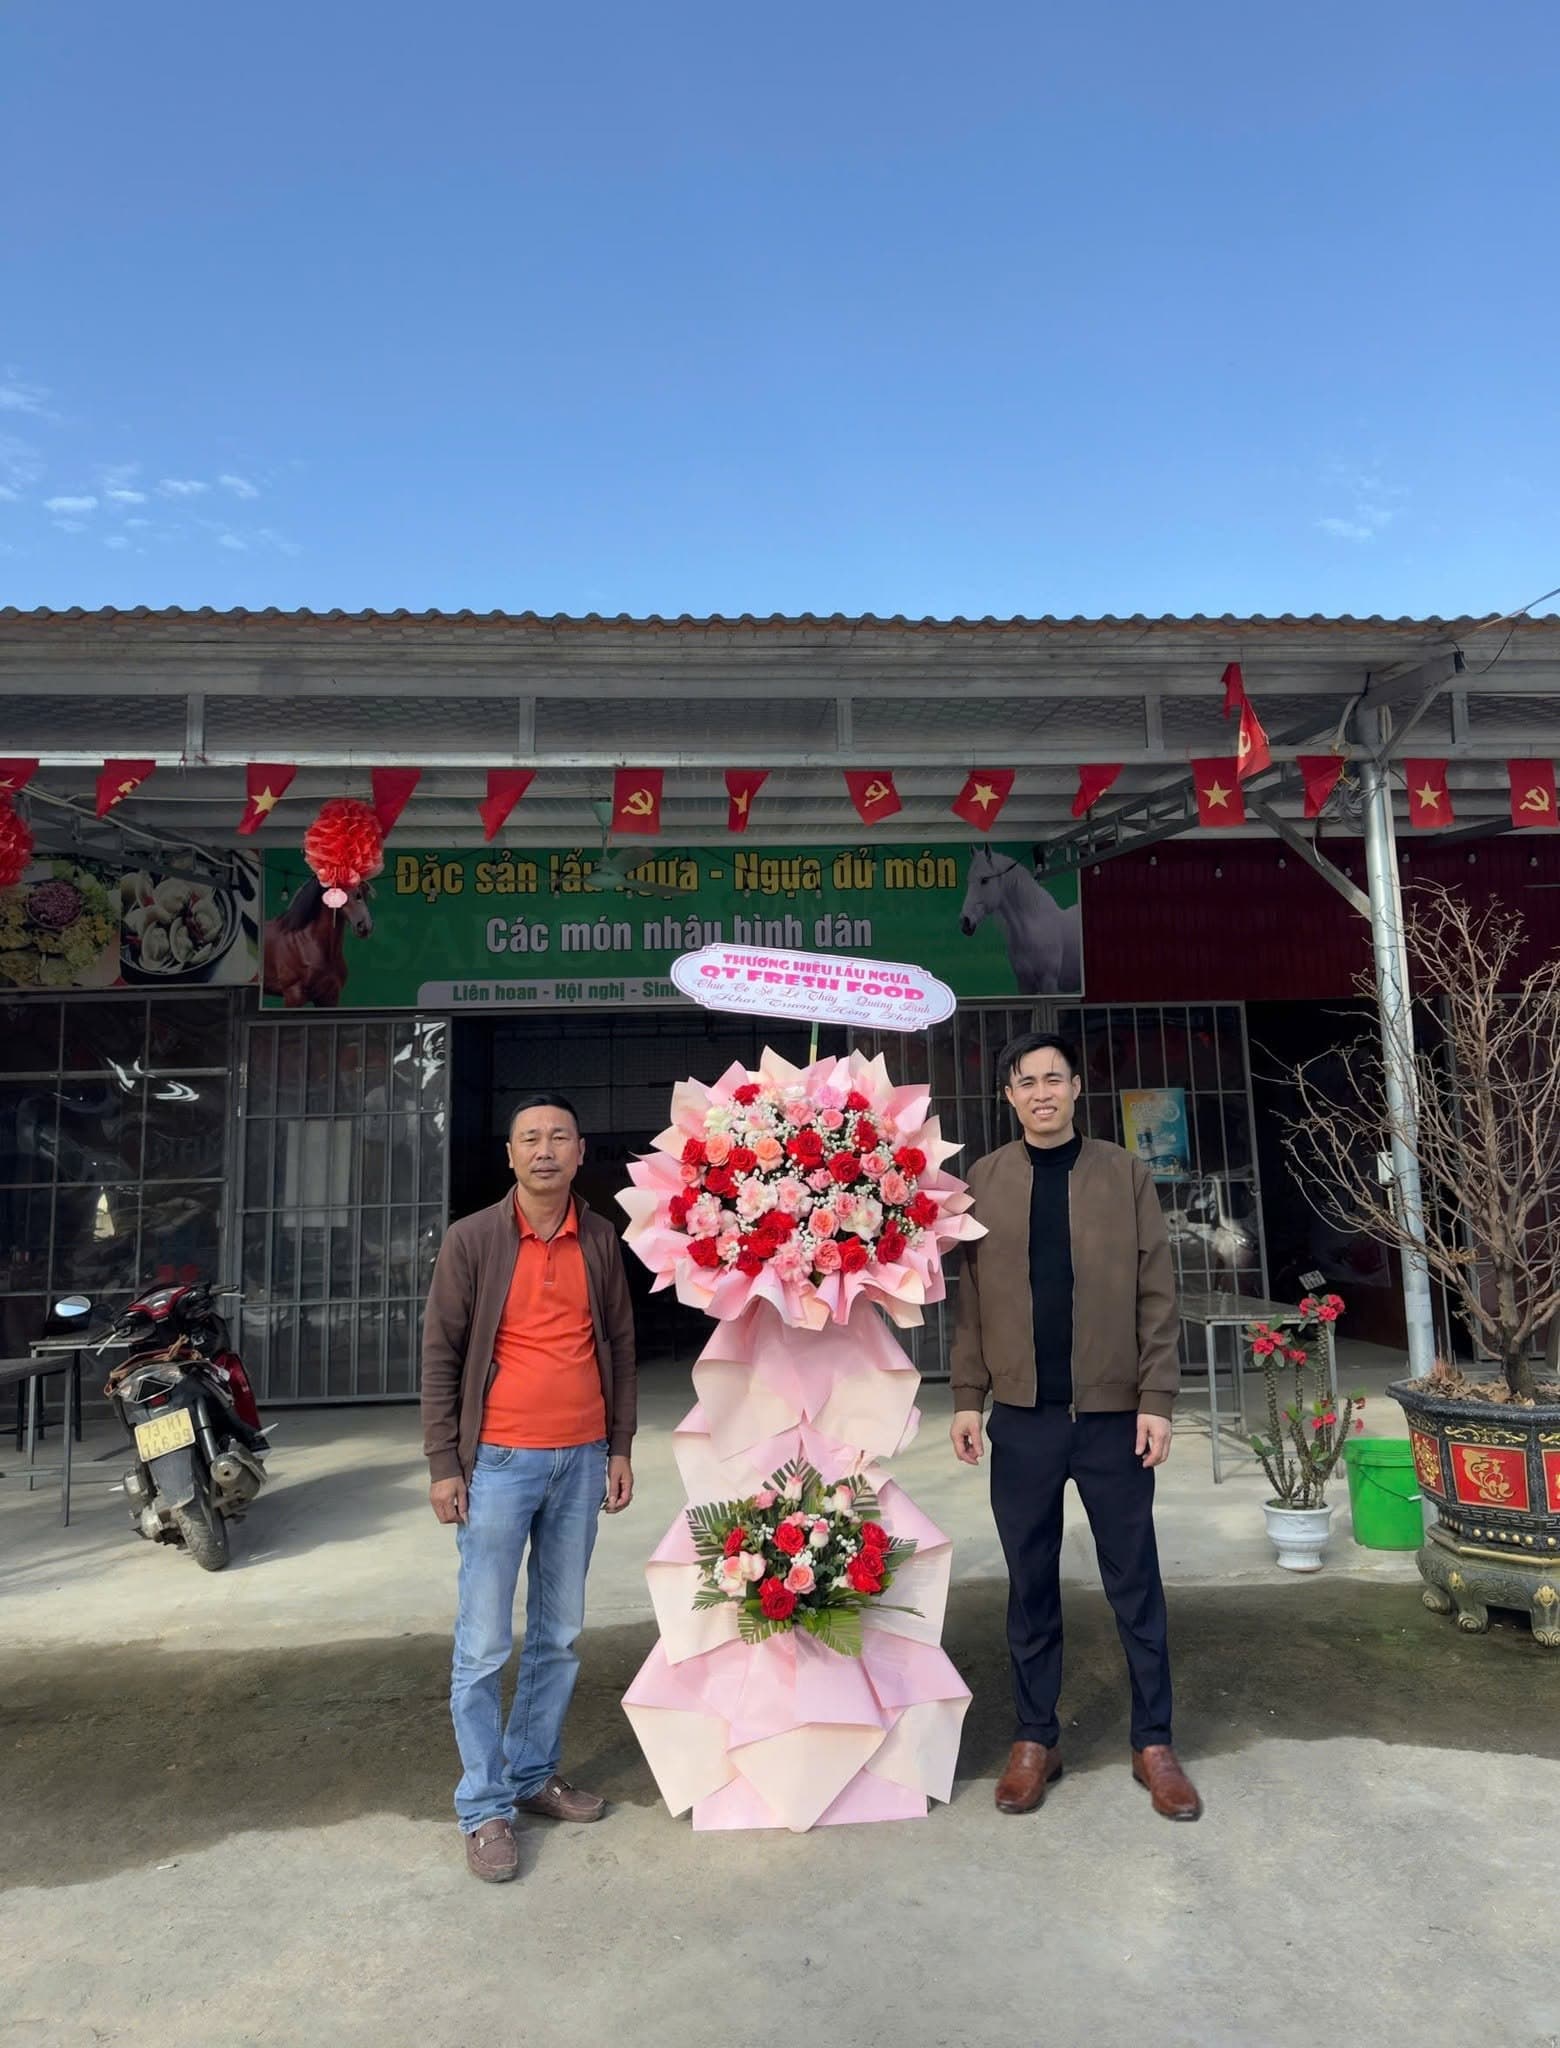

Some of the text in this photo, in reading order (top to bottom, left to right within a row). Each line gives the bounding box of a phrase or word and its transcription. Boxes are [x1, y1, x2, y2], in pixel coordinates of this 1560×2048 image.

[396, 854, 464, 903] Đặc
[475, 850, 537, 894] sản
[734, 852, 821, 898] Ngựa
[832, 848, 874, 889] đủ
[884, 850, 957, 889] món
[486, 917, 550, 953] Các
[560, 914, 632, 952] món
[815, 913, 872, 948] dân
[453, 985, 489, 1001] Liên
[495, 984, 537, 1000] hoan
[588, 981, 625, 1001] nghị
[700, 964, 924, 1000] QT FRESH FOOD
